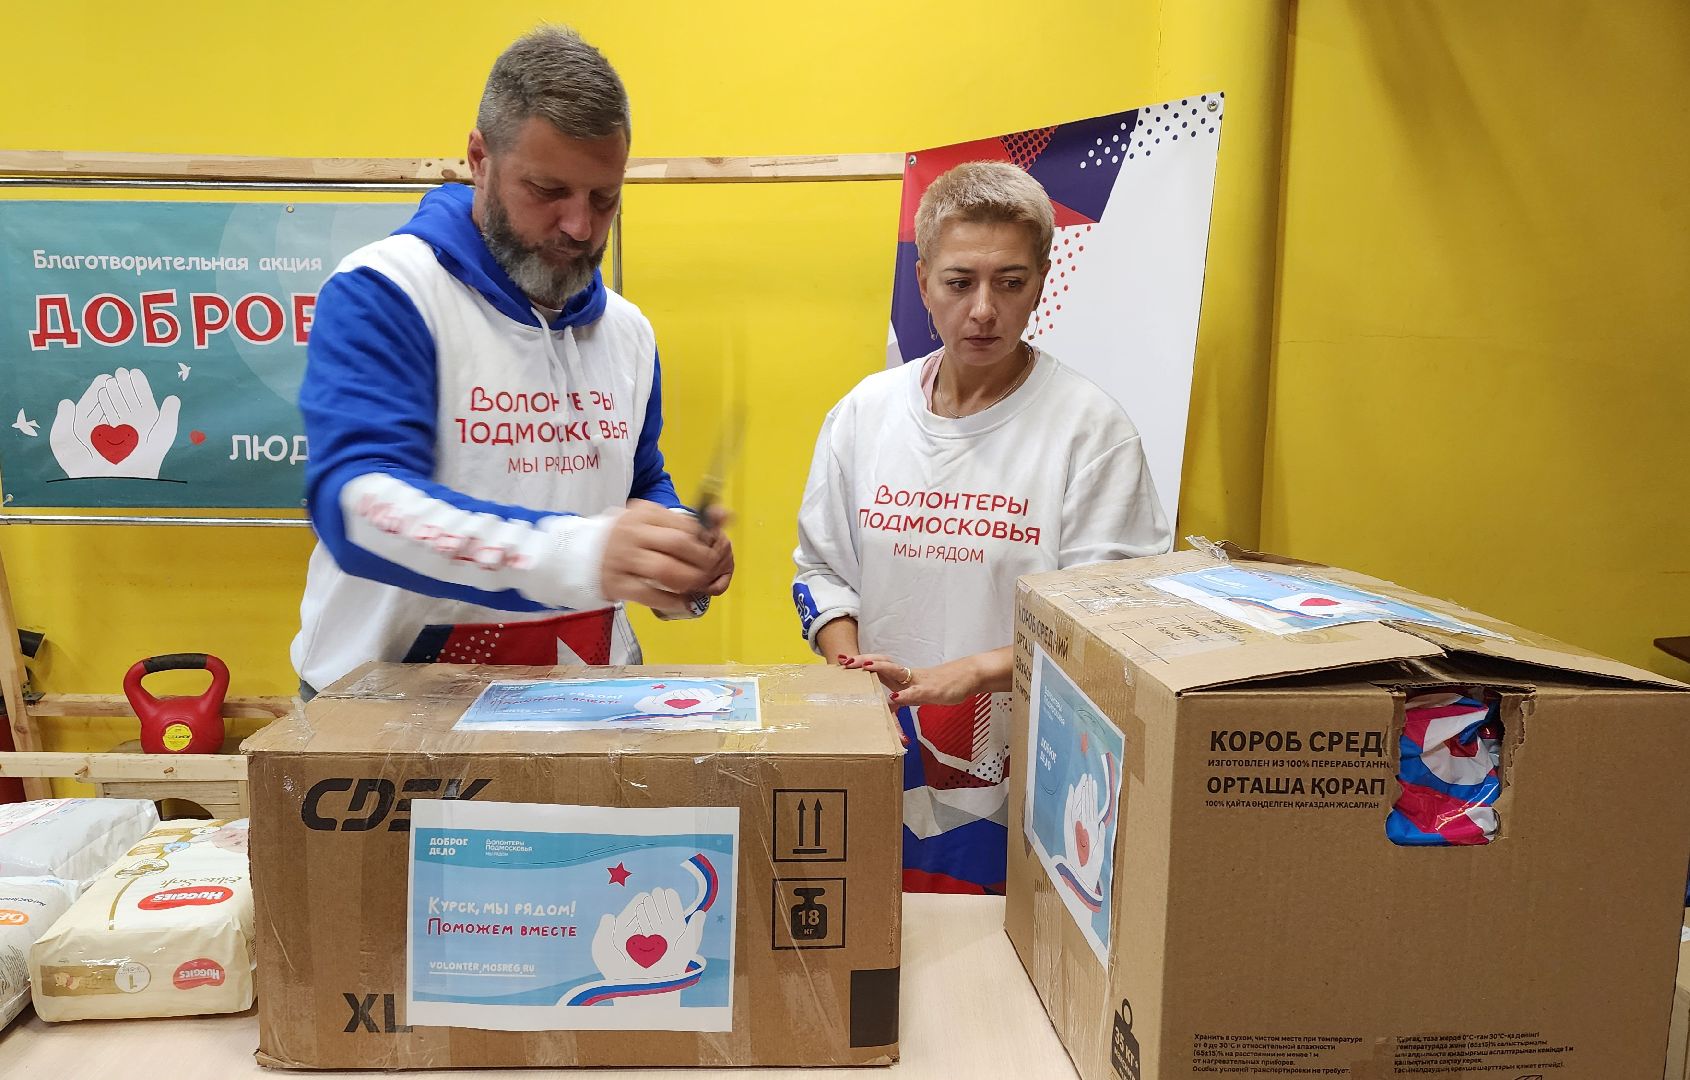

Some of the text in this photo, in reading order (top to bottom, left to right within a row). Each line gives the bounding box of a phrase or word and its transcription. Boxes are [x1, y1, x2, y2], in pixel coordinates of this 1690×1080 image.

[33, 250, 322, 275] Благотворительная акция
[507, 454, 600, 475] МЫ РЯДОМ
[874, 485, 1029, 516] ВОЛОНТЕРЫ
[858, 509, 1041, 546] ПОДМОСКОВЬЯ
[893, 543, 984, 563] МЫ РЯДОМ
[1210, 730, 1303, 752] КОРОБ
[1207, 759, 1270, 767] ИЗГОТОВЛЕН
[1272, 759, 1285, 768] ИЗ
[1286, 760, 1310, 768] 100%
[1207, 777, 1305, 795] ОРТАША
[428, 847, 456, 856] ДЕЛО
[429, 837, 468, 846] ДОБРОЕ
[428, 896, 577, 917] КУРСК, МЫ РЯДОМ!
[428, 918, 577, 937] ПОМОЖЕМ ВМЕСТЕ
[798, 909, 820, 926] 18
[178, 968, 221, 980] HUGGIES
[342, 992, 413, 1033] XL
